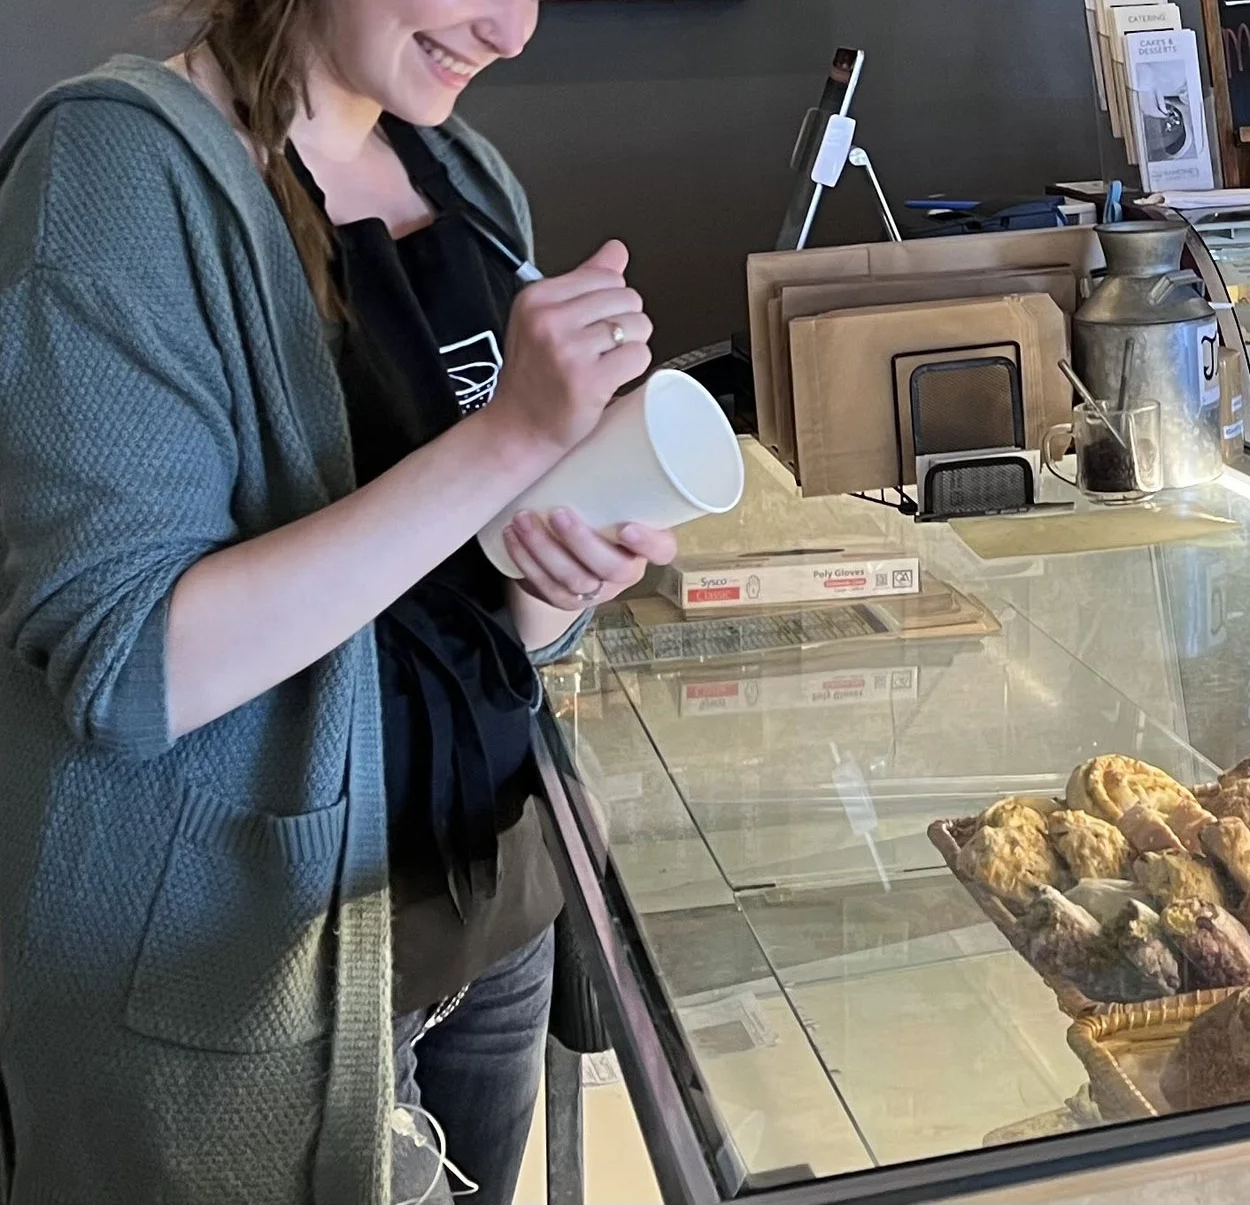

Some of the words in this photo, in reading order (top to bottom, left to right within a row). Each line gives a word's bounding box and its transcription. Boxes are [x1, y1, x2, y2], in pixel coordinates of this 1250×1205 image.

[1128, 13, 1166, 23] CATERING
[1140, 39, 1166, 47] CAKES
[1138, 46, 1177, 55] DESSERTS
[813, 569, 833, 579] Poly
[835, 569, 864, 577] Gloves
[701, 576, 727, 588] Sysco
